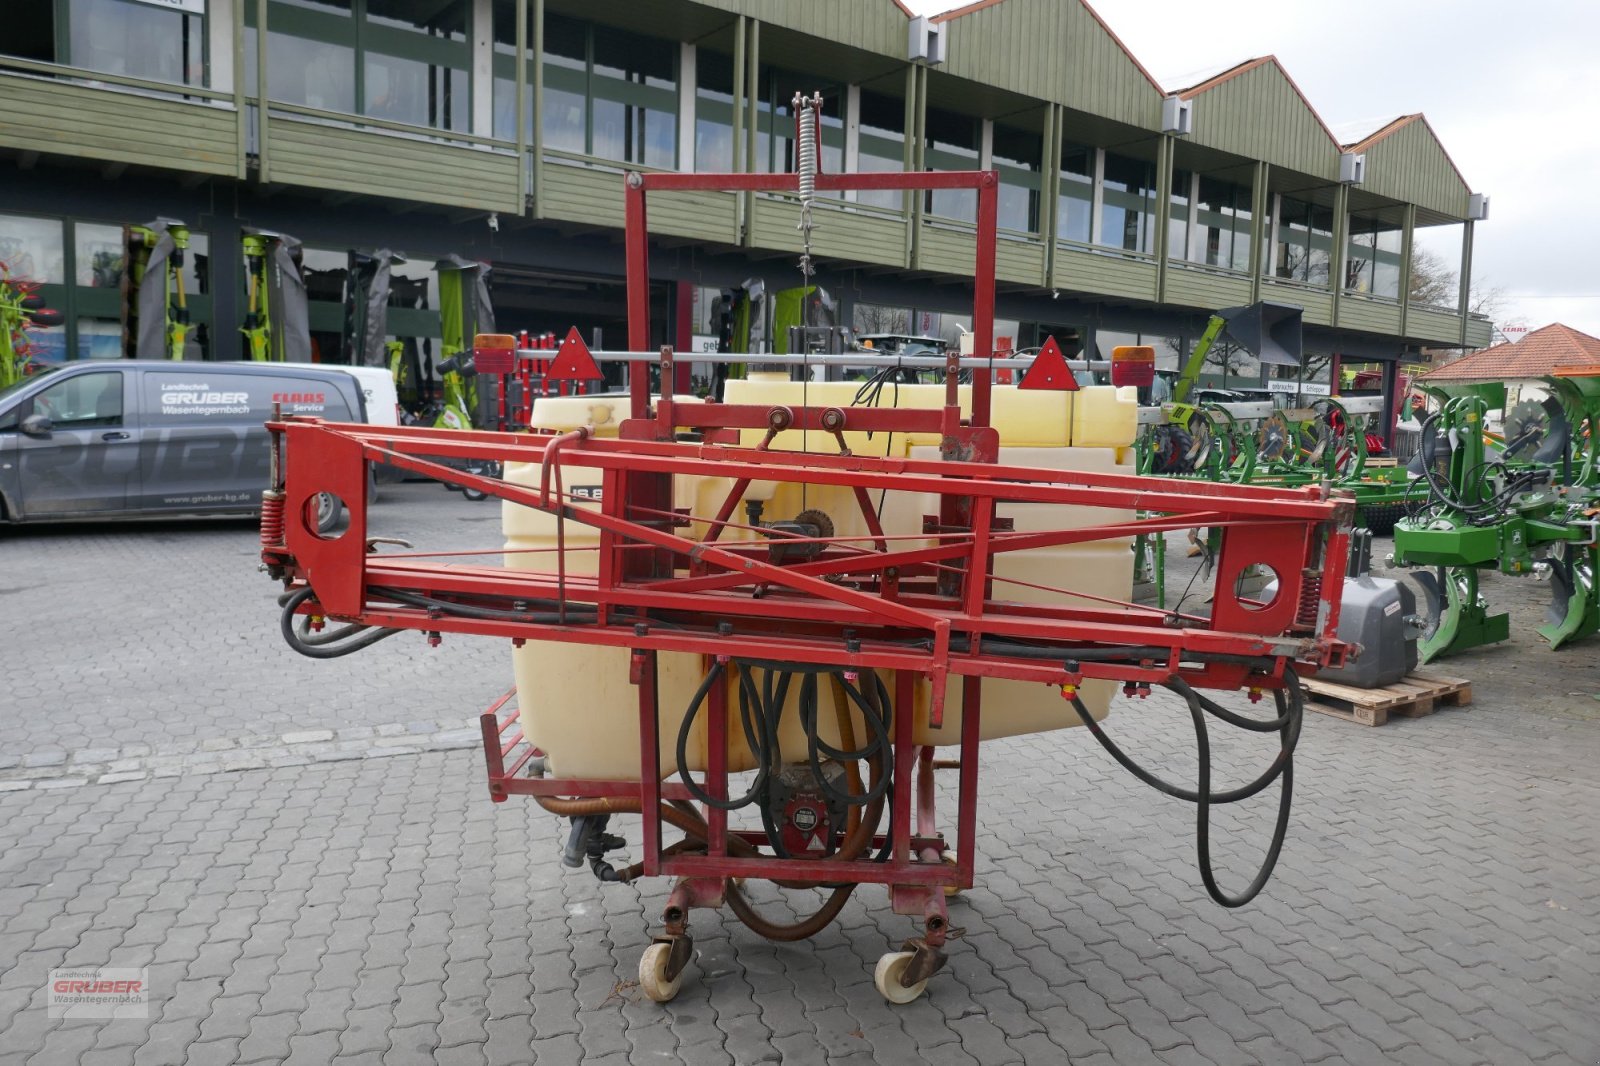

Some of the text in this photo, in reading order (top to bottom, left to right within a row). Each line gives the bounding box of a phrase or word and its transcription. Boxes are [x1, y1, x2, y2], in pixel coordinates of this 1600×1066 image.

[161, 383, 209, 391] Landtechnik
[161, 392, 249, 404] GRUBER
[272, 392, 325, 404] CLAAS
[162, 405, 250, 415] Wasentegernbach
[164, 493, 250, 504] www.gruber-kg.de
